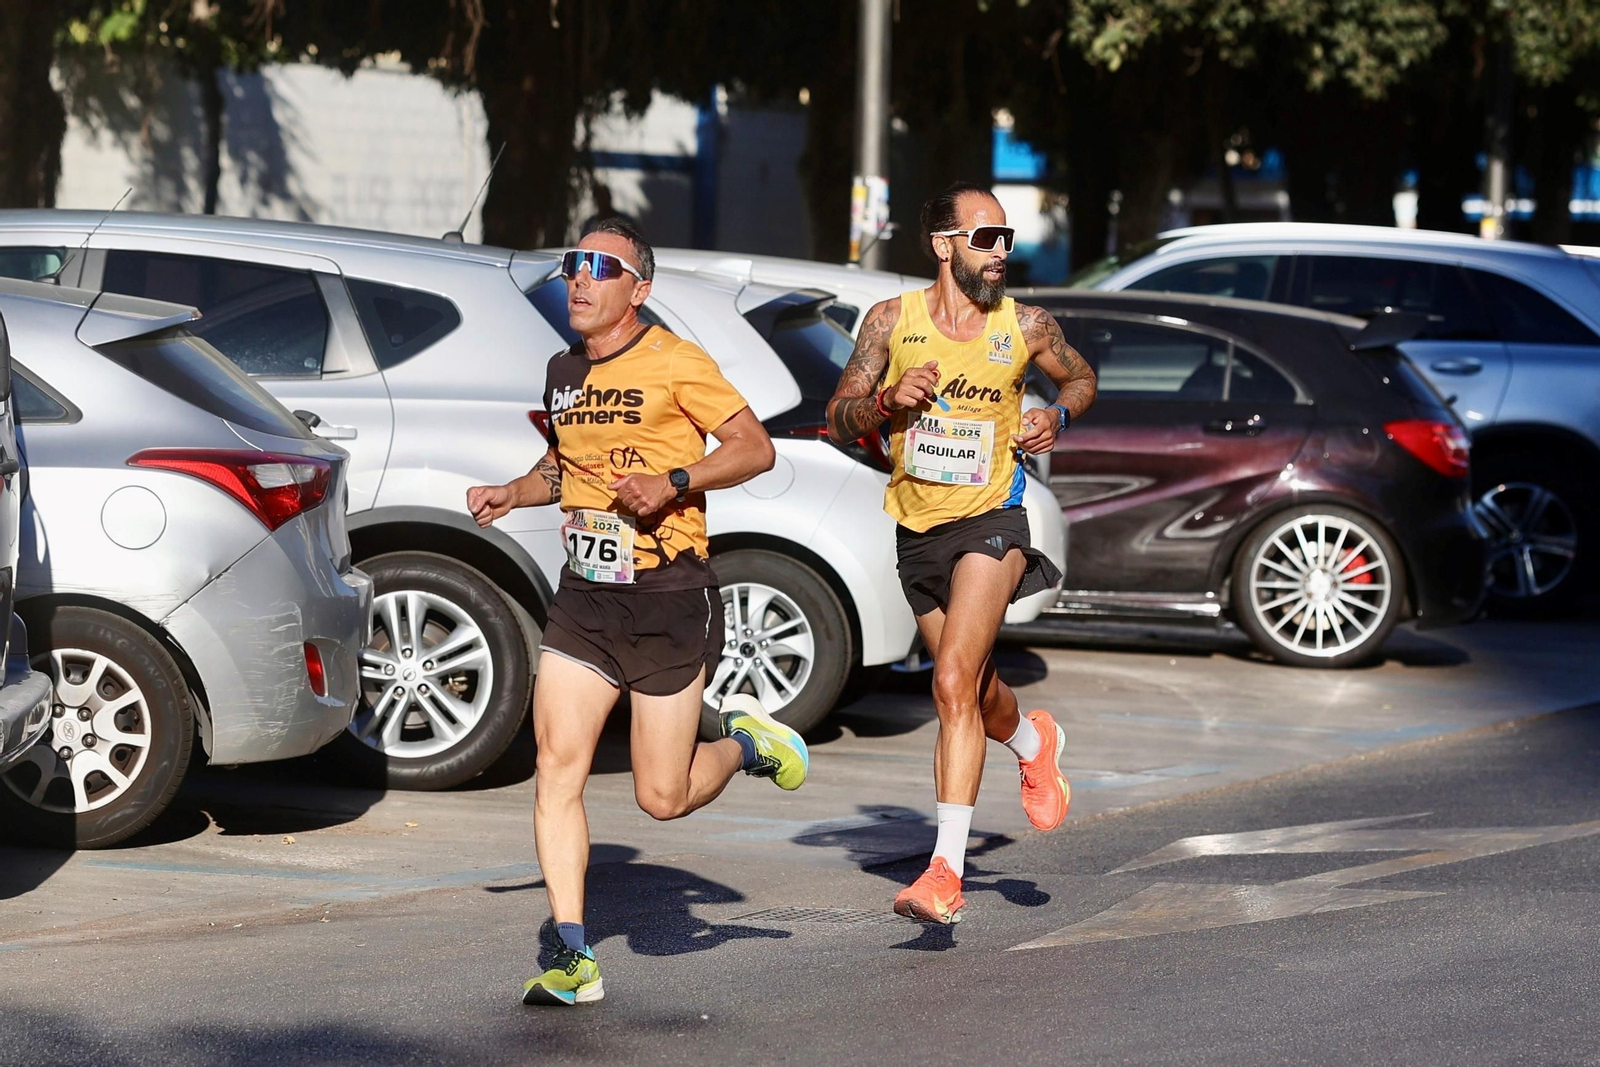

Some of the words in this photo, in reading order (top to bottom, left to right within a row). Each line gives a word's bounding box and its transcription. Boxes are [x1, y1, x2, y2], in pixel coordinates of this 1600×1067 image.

[940, 373, 1003, 403] Álora
[551, 384, 644, 411] bichos
[956, 404, 982, 413] Málaga
[551, 410, 642, 426] runners
[952, 429, 981, 437] 2025
[917, 443, 976, 459] AGUILAR
[592, 521, 620, 532] 2025
[568, 533, 617, 562] 176
